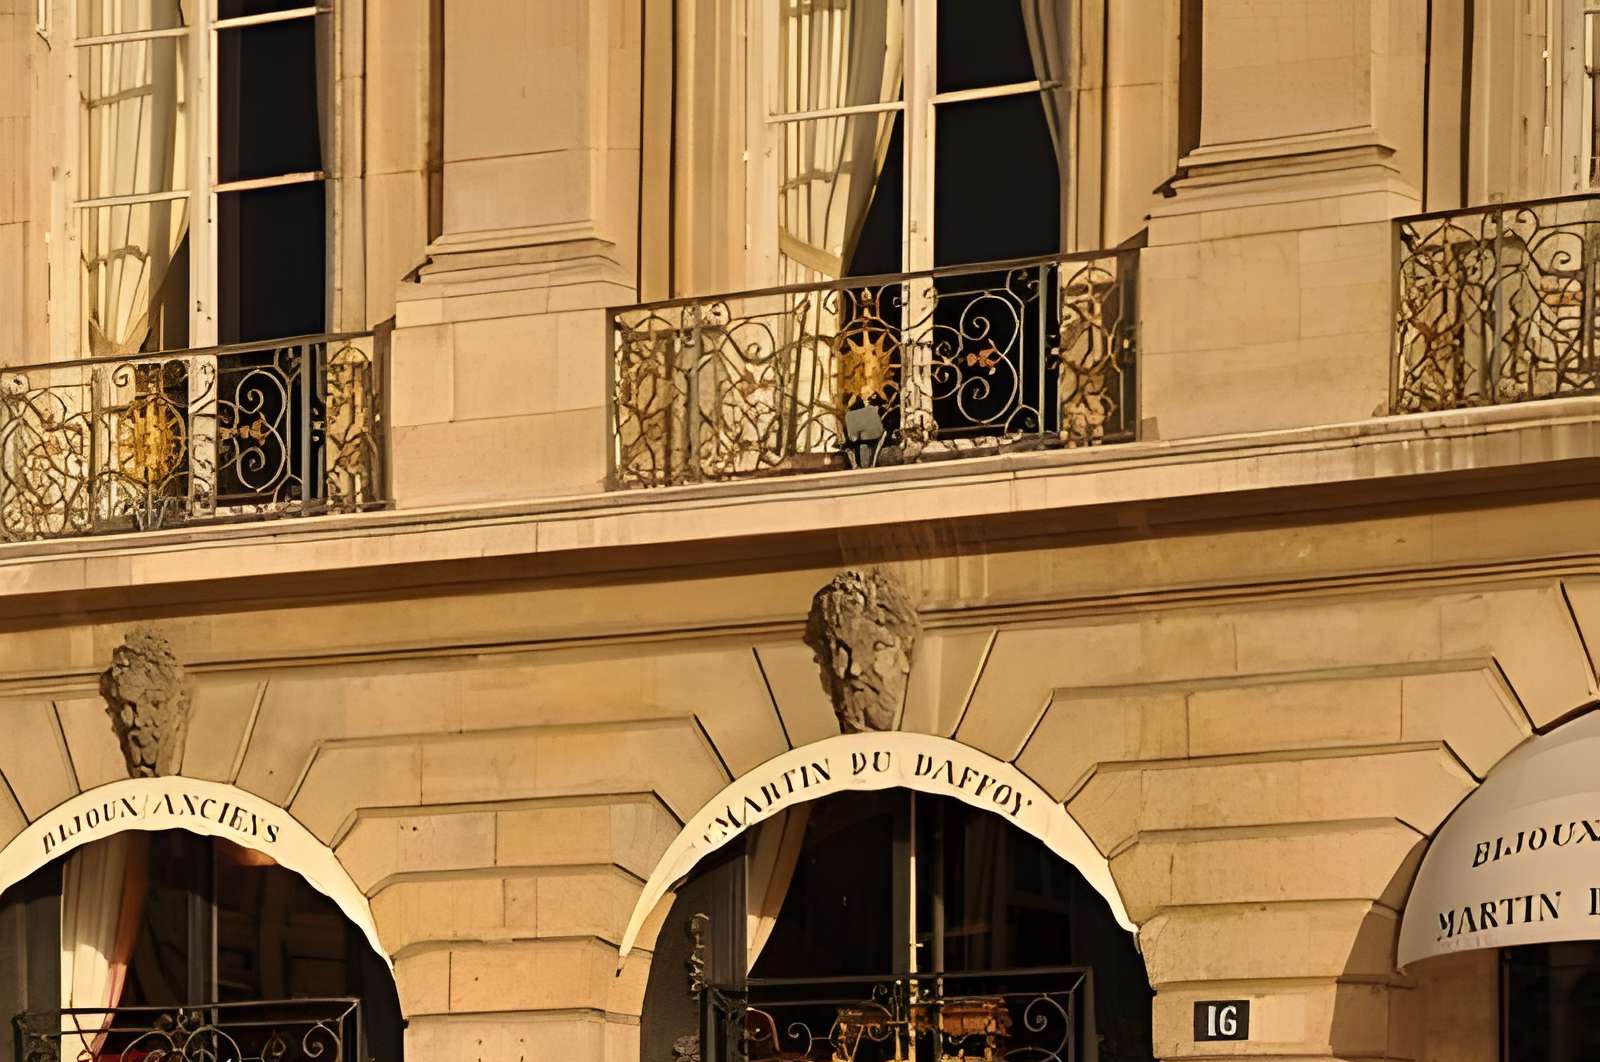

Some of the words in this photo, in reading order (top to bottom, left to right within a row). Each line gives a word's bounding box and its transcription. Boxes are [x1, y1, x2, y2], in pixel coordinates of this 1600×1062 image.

[153, 794, 280, 844] ANCIENS
[704, 757, 830, 845] MARTIN
[851, 751, 891, 775] DU
[915, 753, 1032, 817] DAFFOY
[1437, 891, 1562, 942] MARTIN
[1208, 1005, 1237, 1037] 16
